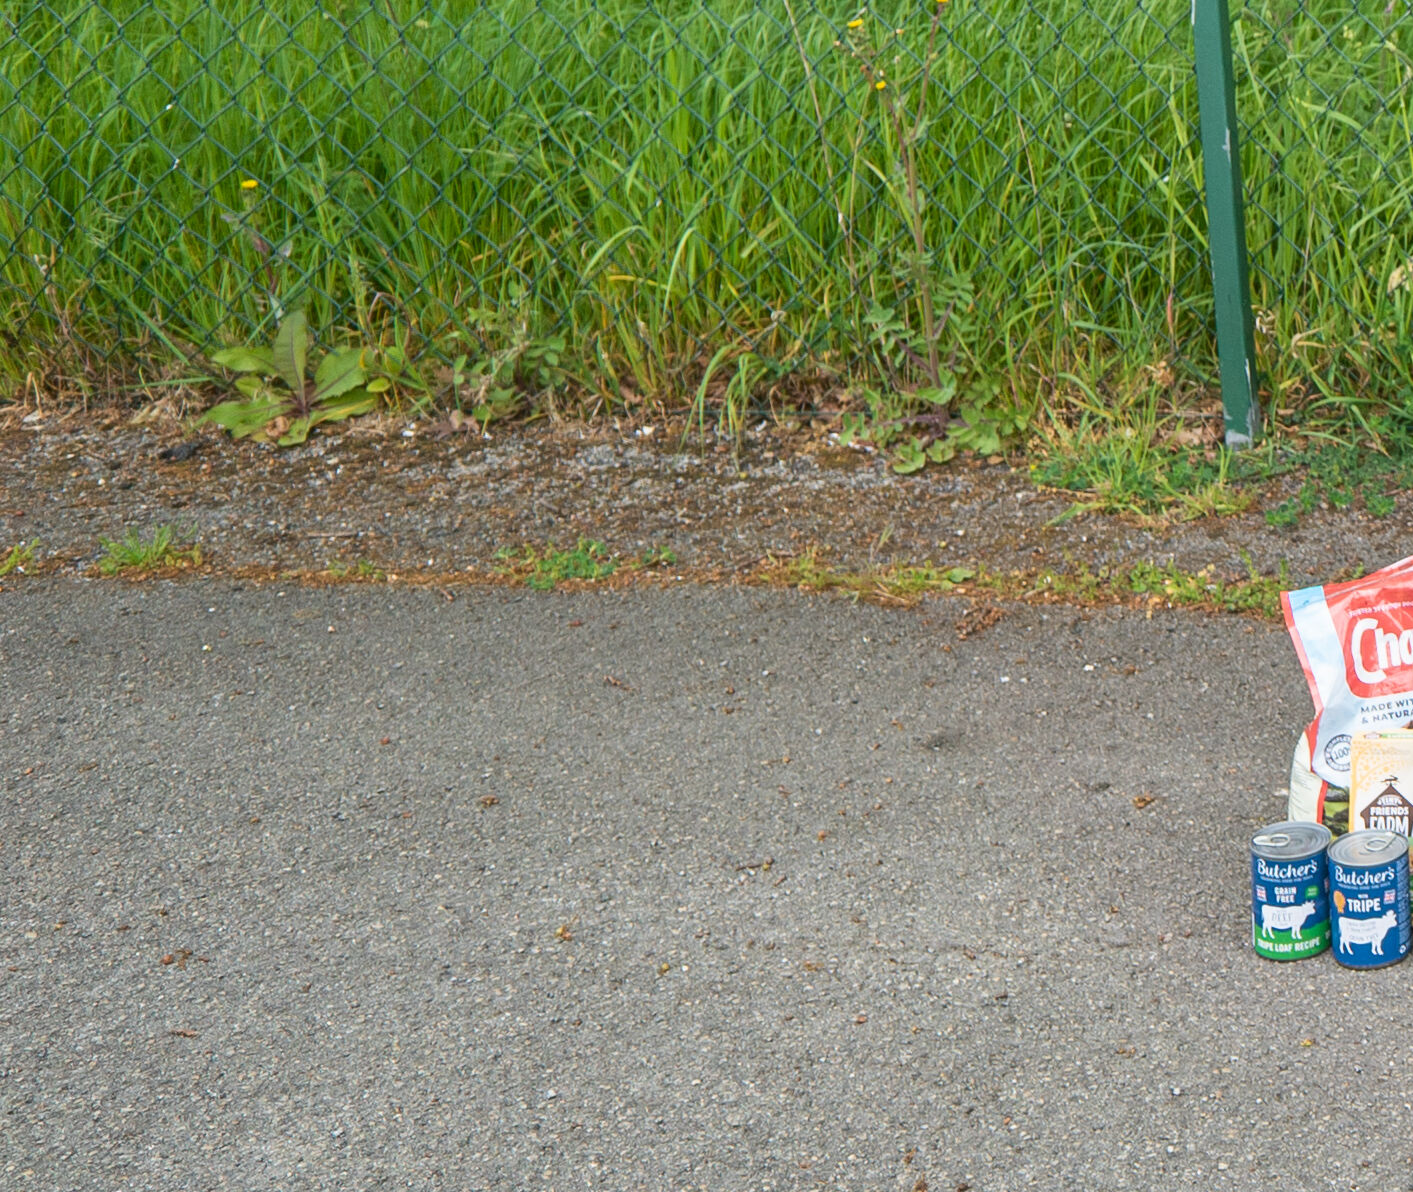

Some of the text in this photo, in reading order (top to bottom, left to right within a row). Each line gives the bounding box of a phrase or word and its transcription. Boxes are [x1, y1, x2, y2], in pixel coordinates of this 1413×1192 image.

[1360, 699, 1393, 714] MADE
[1334, 746, 1350, 760] 100
[1369, 806, 1409, 816] FRIENDS
[1256, 858, 1318, 879] Butcher's
[1335, 865, 1395, 886] Butcher's
[1274, 886, 1297, 895] GRAIN
[1346, 898, 1382, 913] TRIPE
[1274, 943, 1293, 953] LOAF
[1294, 937, 1320, 952] RECIPE
